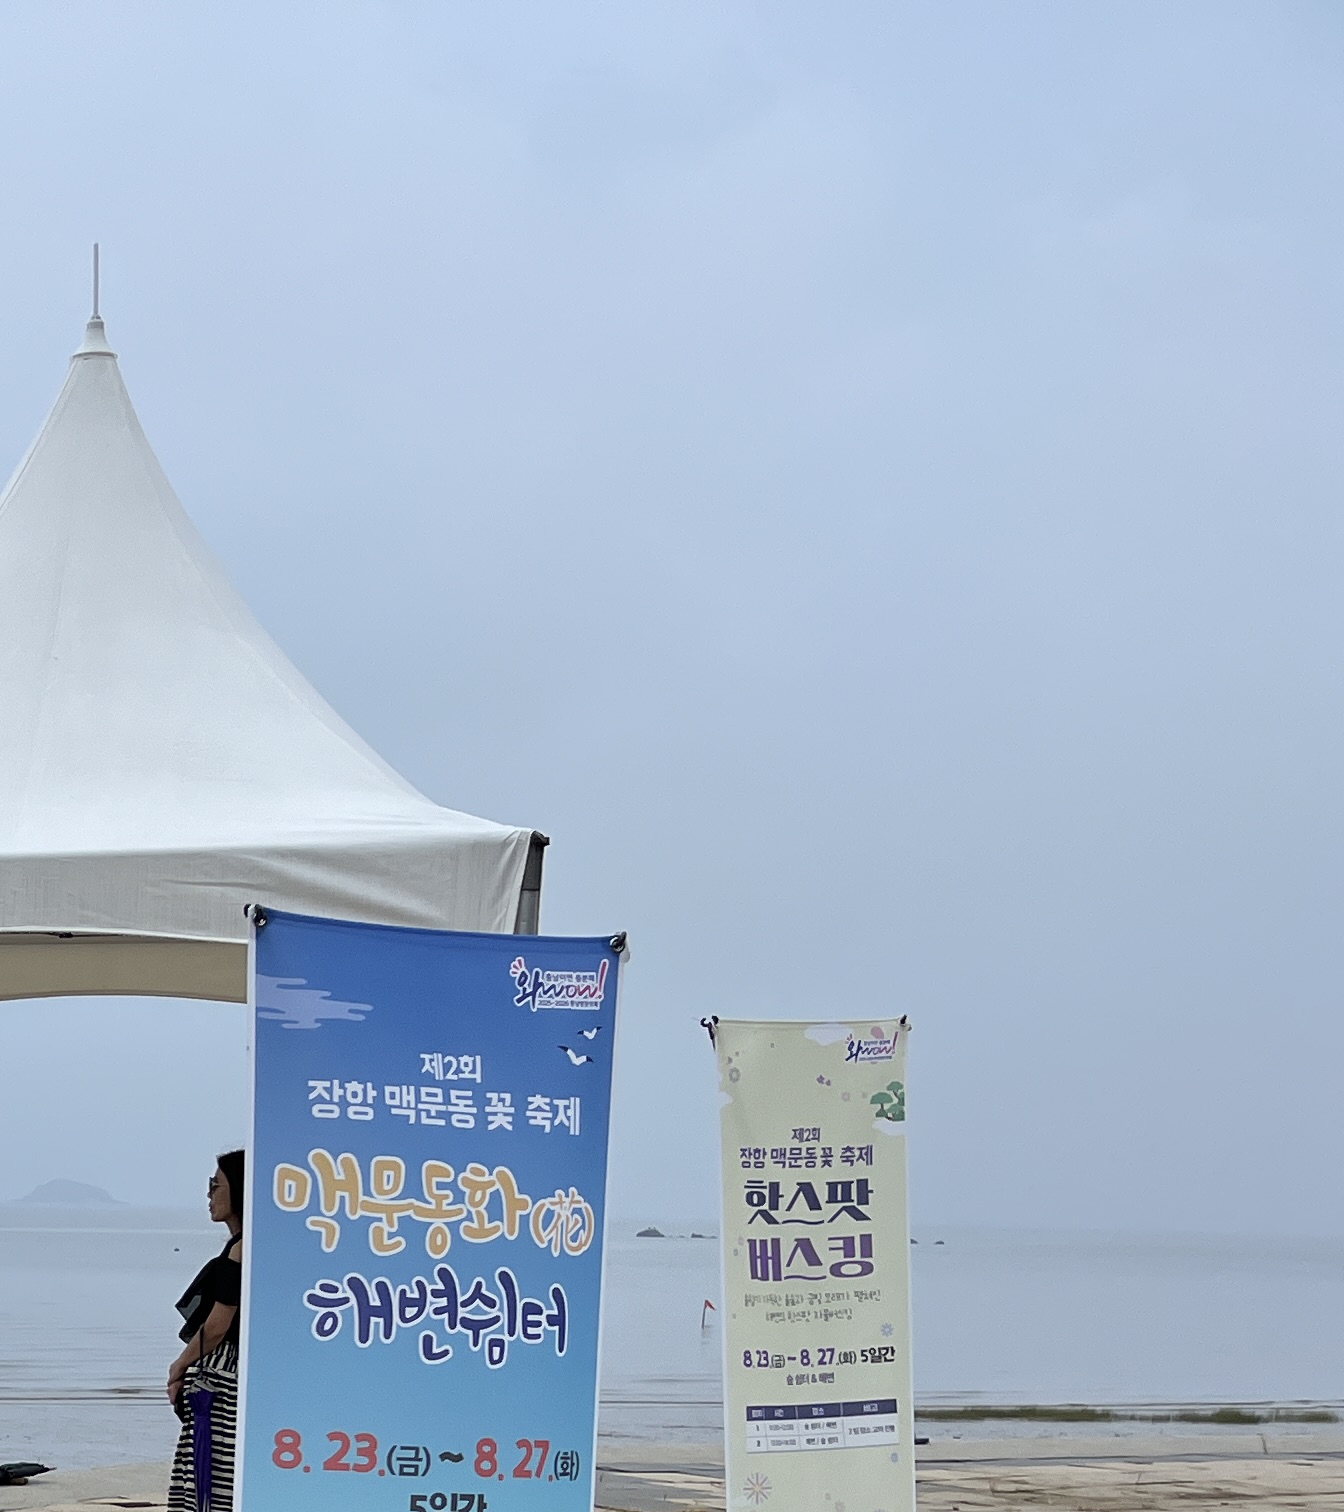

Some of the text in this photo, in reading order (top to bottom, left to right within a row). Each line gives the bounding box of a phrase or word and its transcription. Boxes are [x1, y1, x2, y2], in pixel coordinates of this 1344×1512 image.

[419, 1052, 483, 1083] 제2회
[307, 1080, 581, 1136] 장항 맥문동 꽃 축제
[739, 1145, 874, 1169] 장항 맥문동 꽃 축제
[791, 1127, 821, 1143] 제2회
[743, 1178, 874, 1225] 핫스팟
[747, 1233, 875, 1282] 버스킹
[304, 1263, 569, 1369] 해변쉼터
[860, 1346, 896, 1364] 5일간
[271, 1428, 311, 1474] 8.
[473, 1438, 505, 1481] 8.
